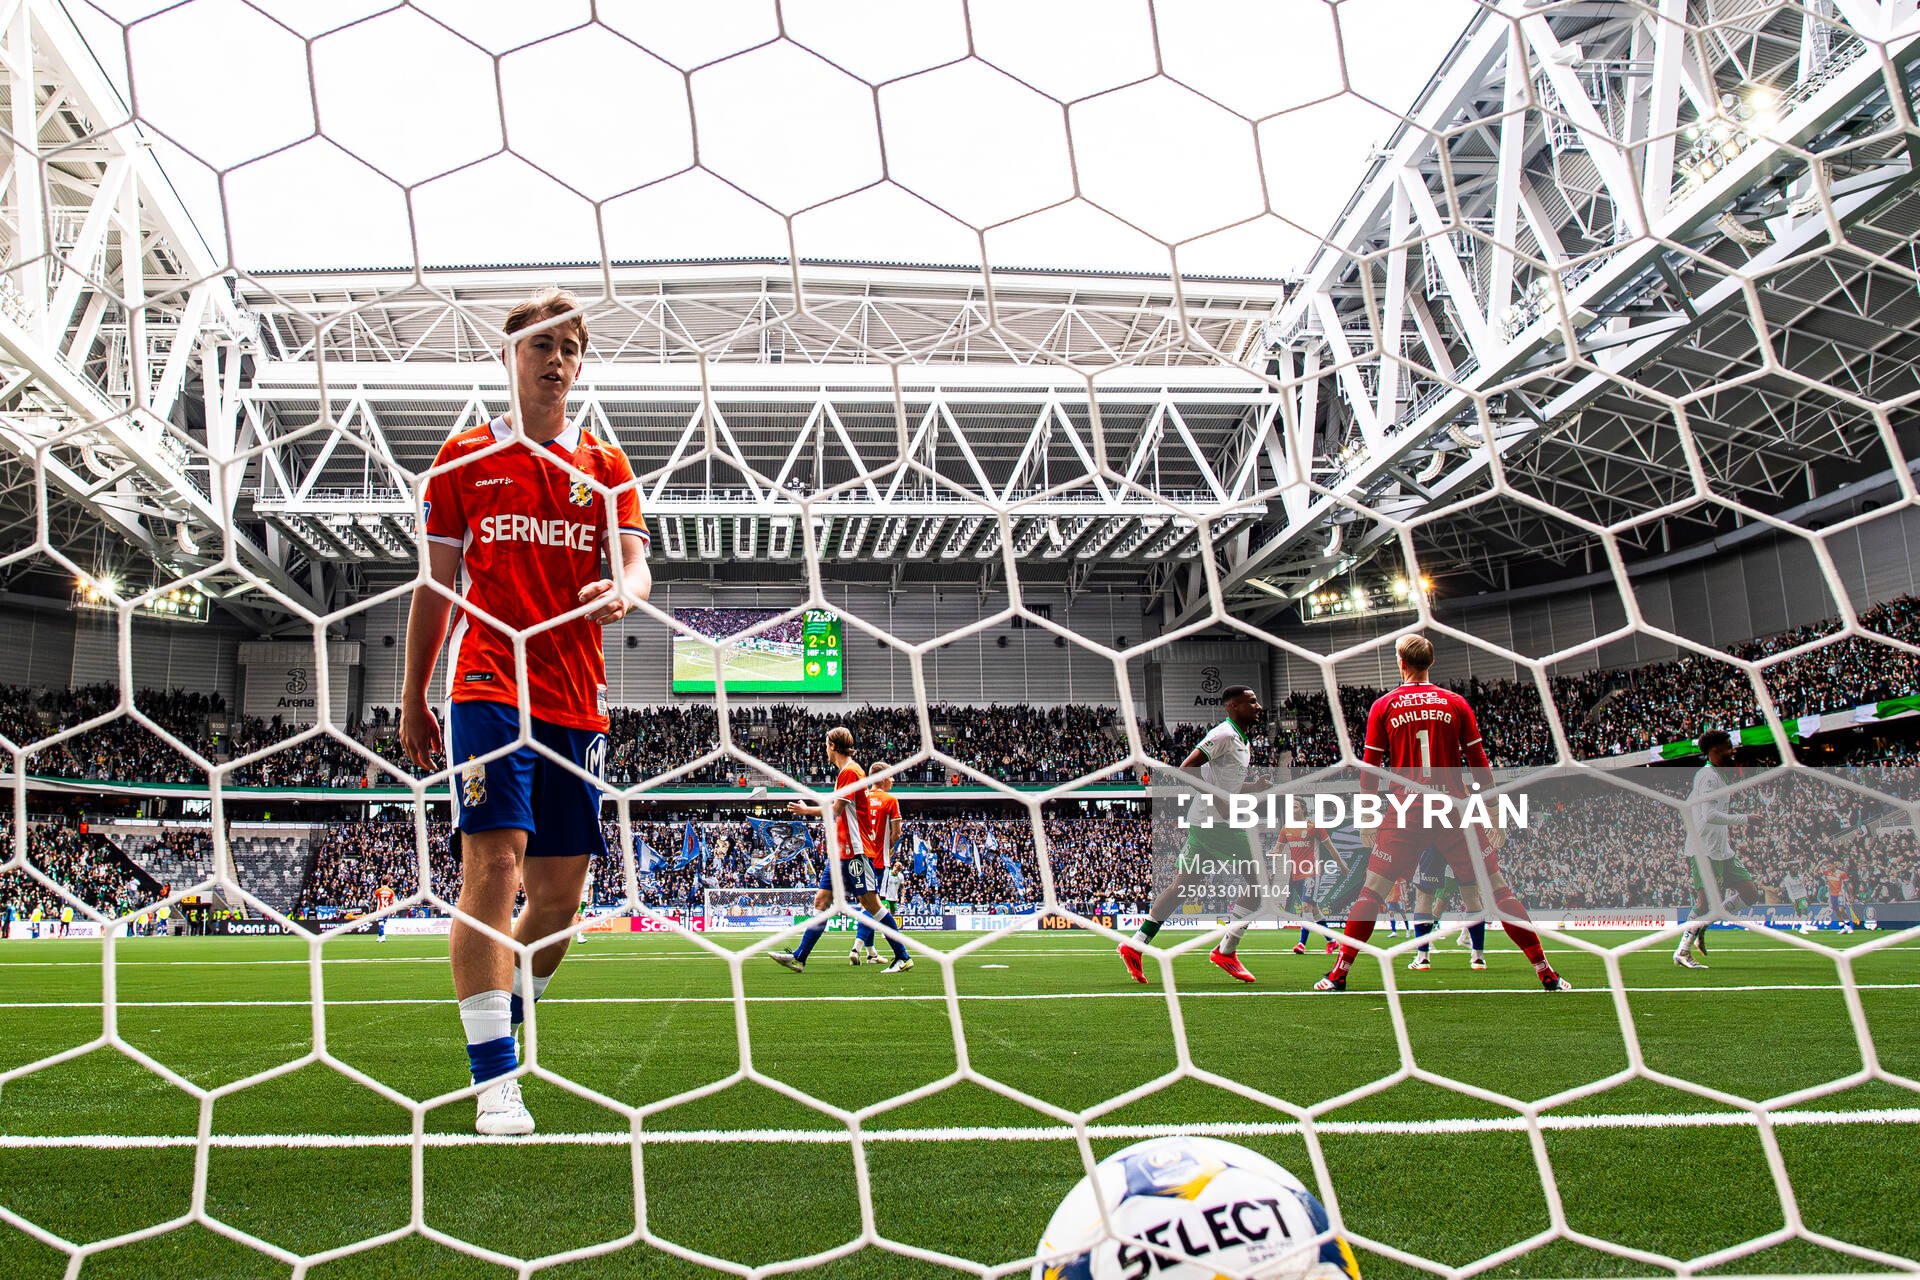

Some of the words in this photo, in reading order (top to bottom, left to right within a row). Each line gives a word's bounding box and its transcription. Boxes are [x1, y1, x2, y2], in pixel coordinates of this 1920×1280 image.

[457, 435, 489, 447] FAMECO
[475, 478, 505, 487] CRAFT
[480, 514, 596, 552] SERNEKE
[805, 610, 838, 623] 72:39
[808, 634, 818, 648] 2
[827, 634, 837, 648] 0
[277, 696, 315, 708] Arena
[1194, 695, 1224, 706] Aren
[1398, 691, 1438, 701] NORDIC
[1391, 697, 1448, 709] WELLNESS
[1390, 709, 1452, 729] DAHLBERG
[1415, 729, 1431, 778] 1
[849, 861, 864, 877] MG
[902, 915, 944, 926] PROJOB
[971, 917, 1022, 930] Flinks
[1133, 917, 1199, 927] INSPORT
[227, 921, 266, 934] beans
[268, 921, 281, 934] in
[1117, 1199, 1292, 1280] SELECT
